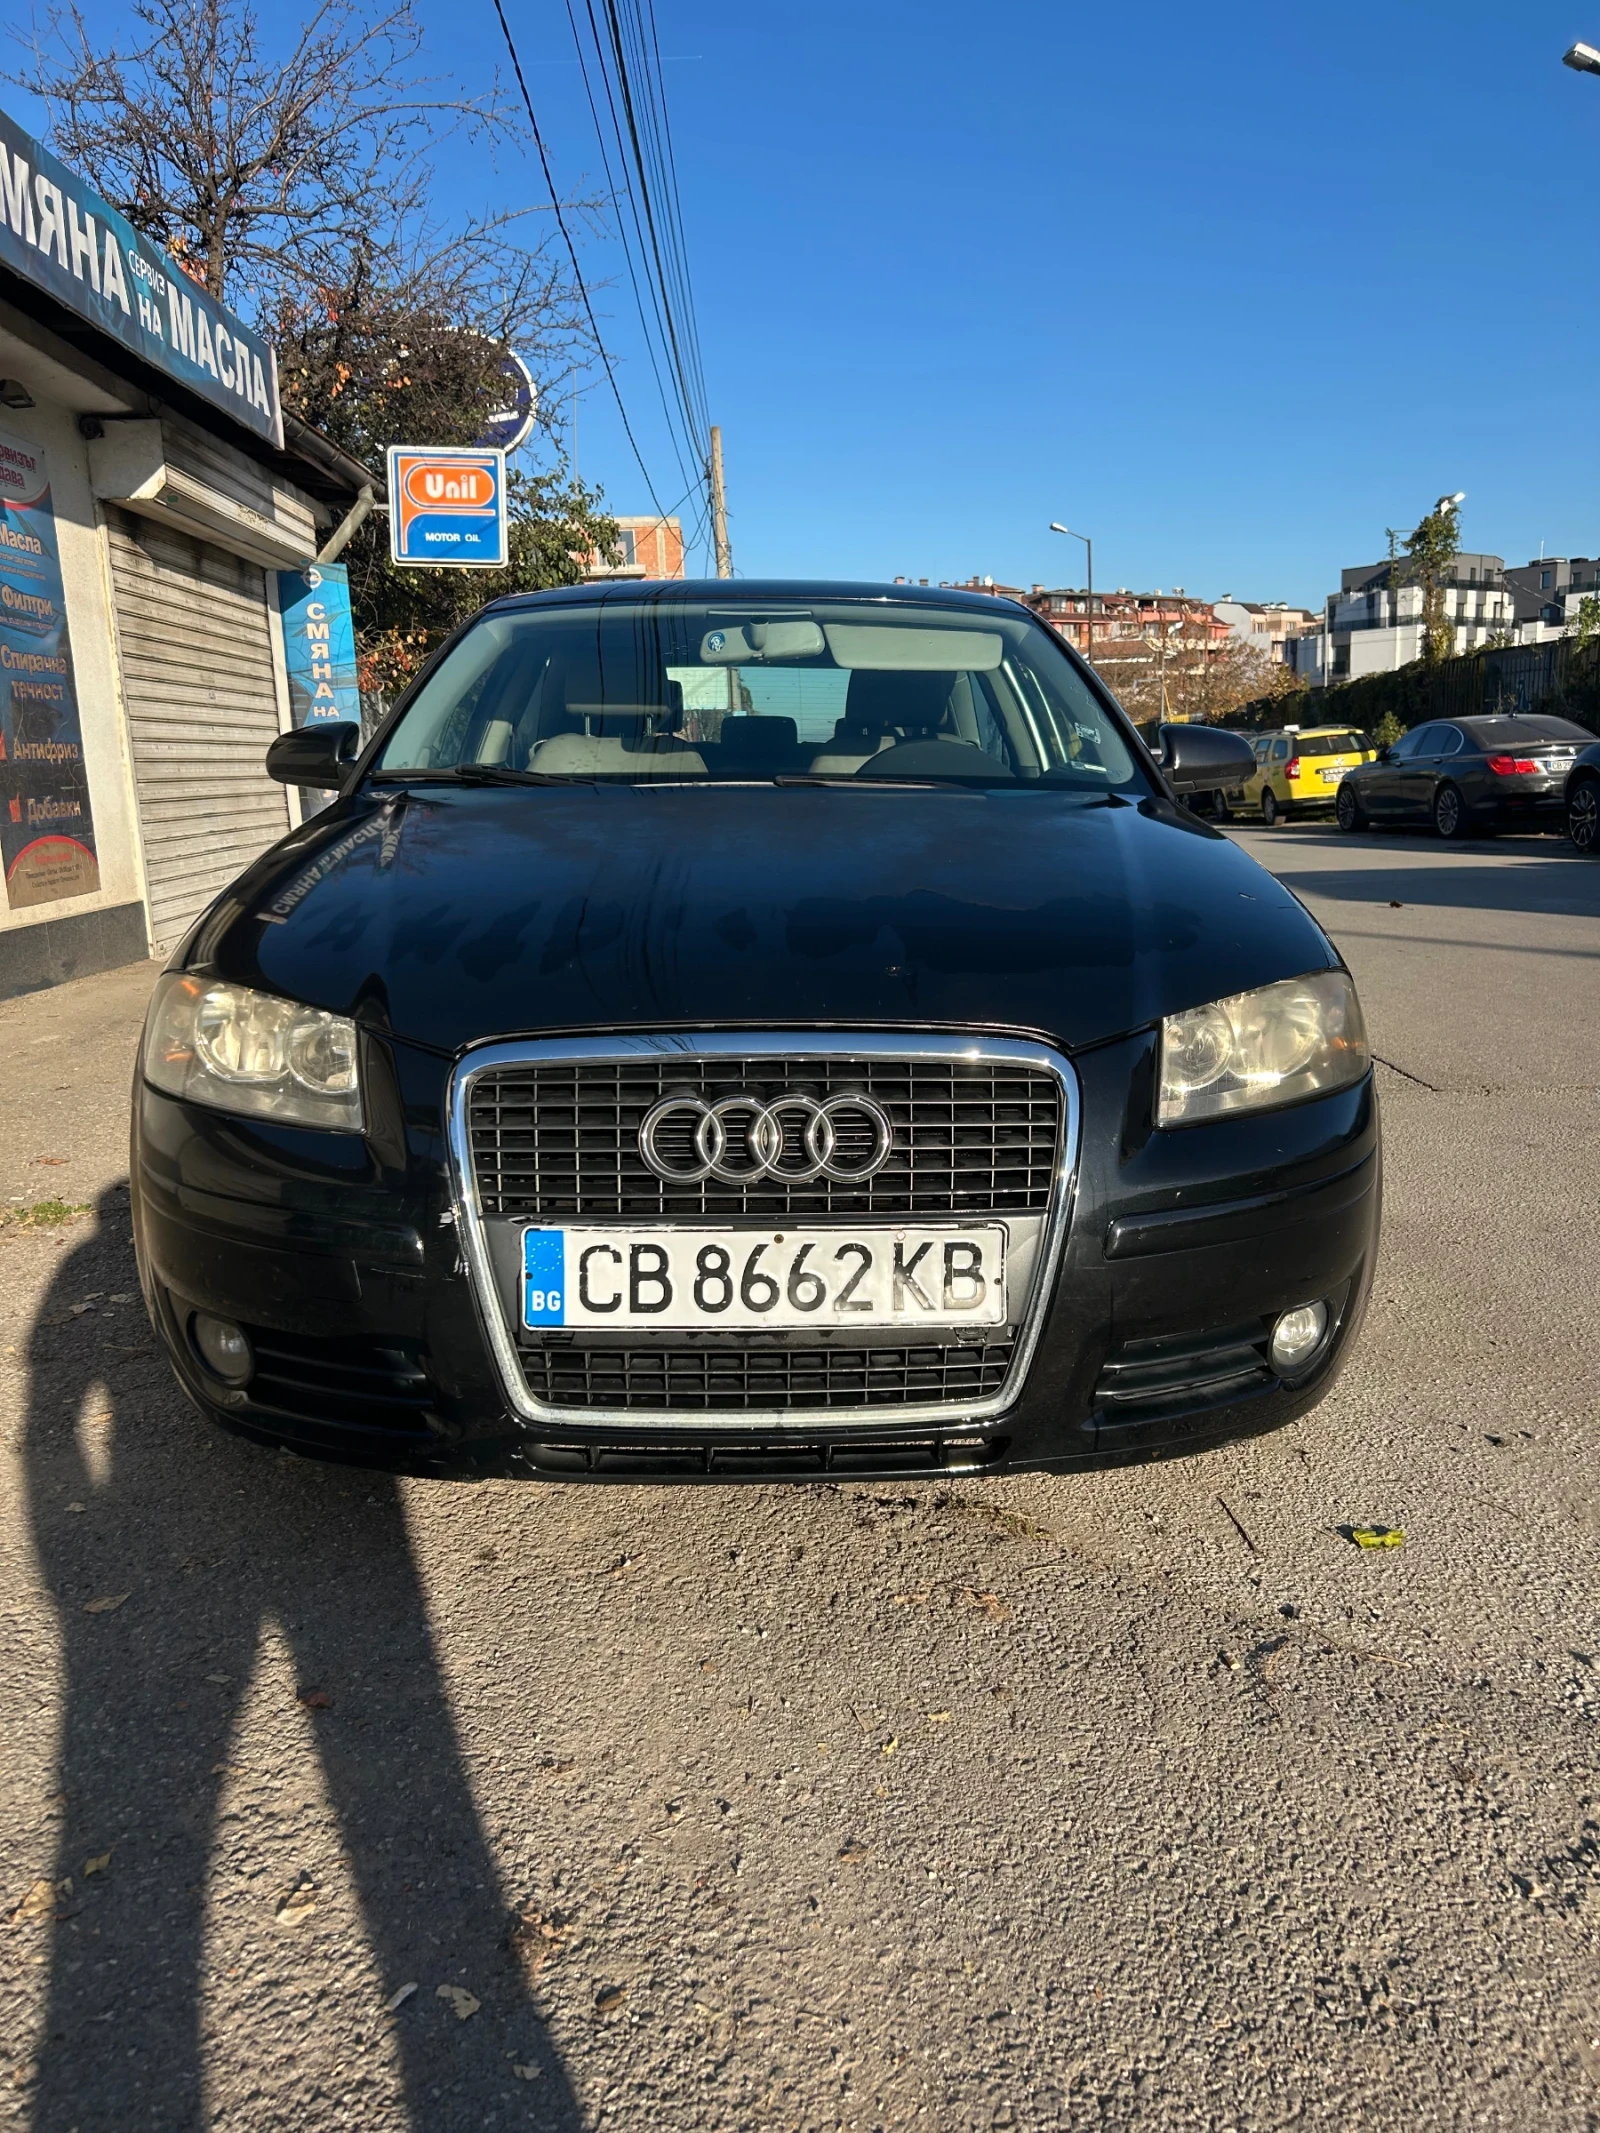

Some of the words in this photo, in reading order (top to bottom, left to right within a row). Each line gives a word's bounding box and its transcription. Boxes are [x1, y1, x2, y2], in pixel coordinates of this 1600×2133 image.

[128, 250, 167, 296] СЕРВИЗ
[138, 292, 164, 341] НА
[167, 280, 271, 417] МАСЛА
[425, 474, 477, 499] Unil
[0, 523, 42, 556] Масла
[425, 532, 461, 542] MOTOR
[465, 533, 481, 542] OIL
[2, 585, 53, 619] Филтри
[1, 645, 67, 676] Спирачна
[306, 603, 334, 698] СМЯНА
[12, 680, 63, 700] течност
[313, 706, 340, 717] НА
[14, 736, 78, 764] Антифриз
[27, 796, 81, 825] Добавки
[578, 1243, 673, 1313] CB
[693, 1243, 874, 1313] 8662
[892, 1242, 986, 1311] KB
[531, 1290, 561, 1311] BG
